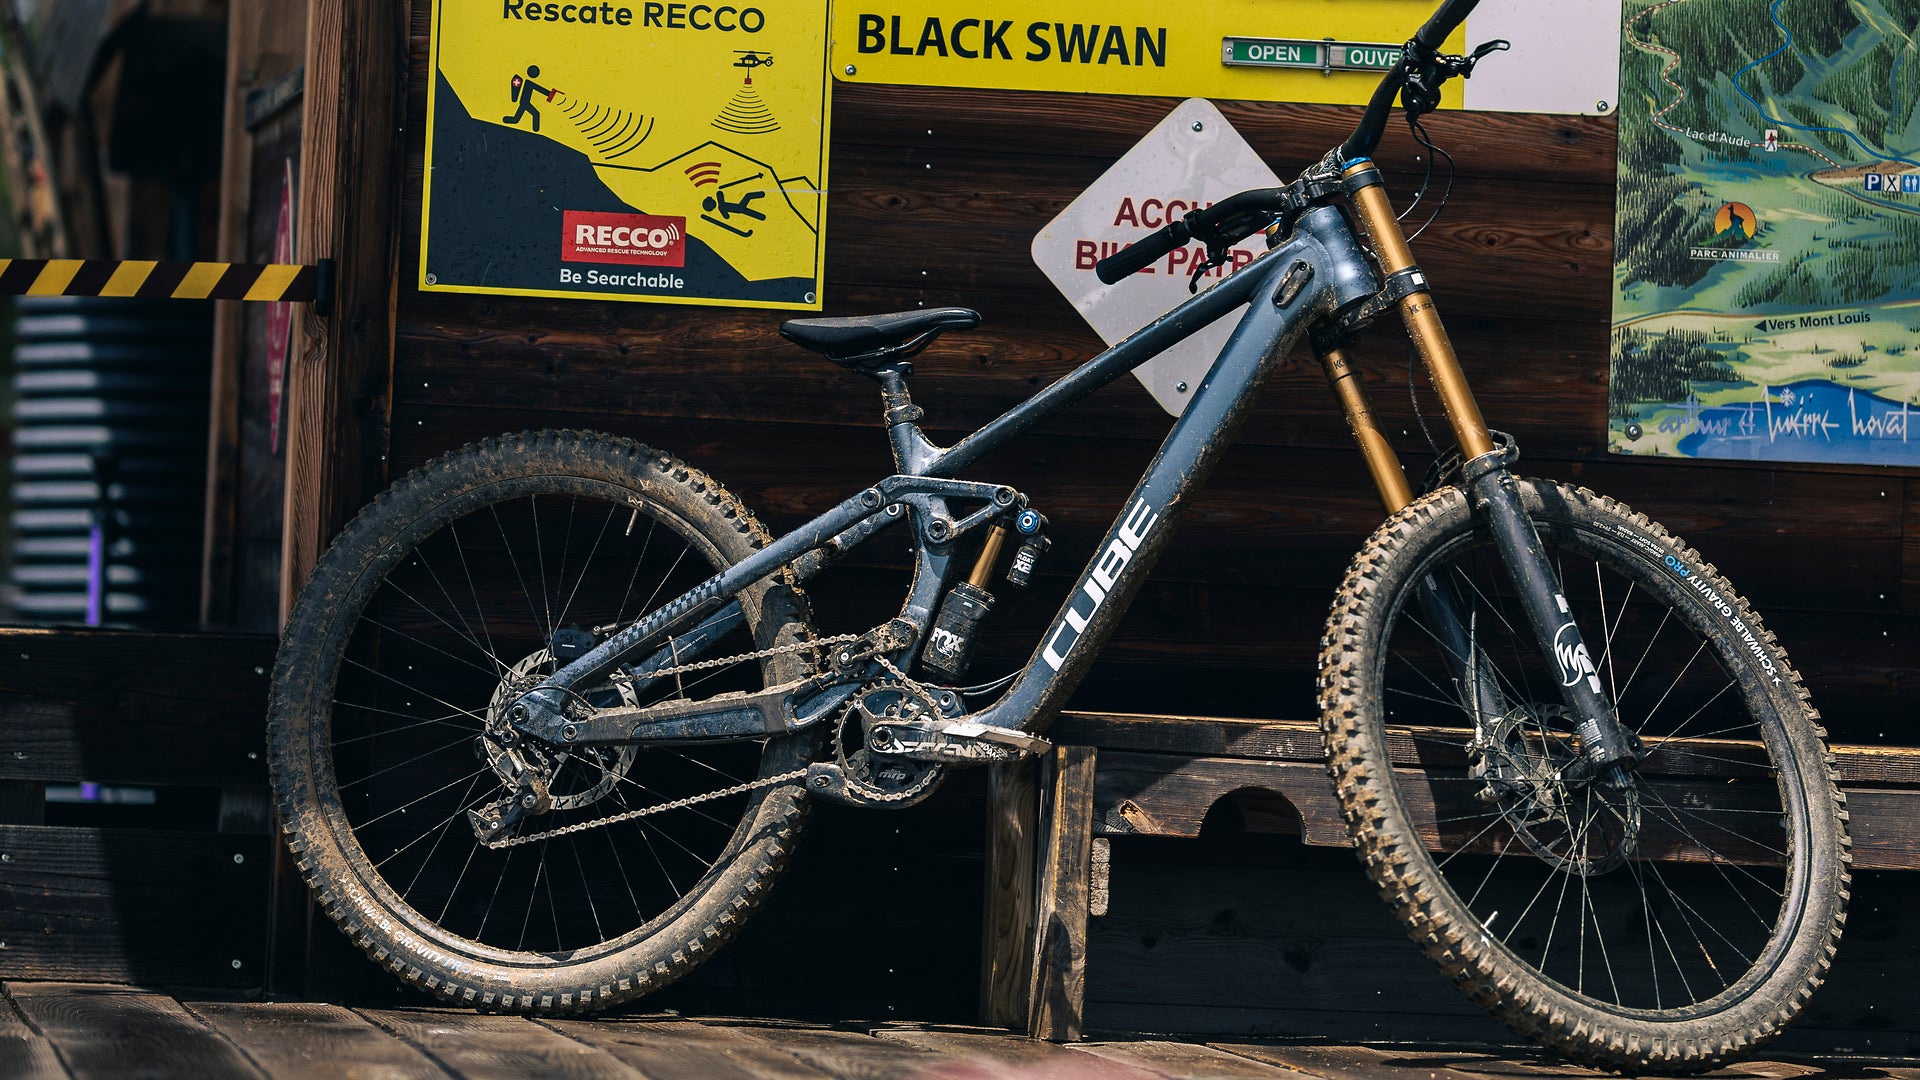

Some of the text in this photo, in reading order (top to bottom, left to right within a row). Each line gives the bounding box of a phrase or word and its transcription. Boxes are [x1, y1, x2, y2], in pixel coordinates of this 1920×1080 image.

[503, 0, 765, 33] Rescate RECCO
[857, 13, 1167, 68] BLACK SWAN
[1248, 45, 1300, 62] OPEN
[1350, 50, 1404, 66] OUVE
[1686, 127, 1751, 147] Lac d'Aude
[575, 224, 669, 248] RECCO
[575, 246, 606, 254] ADVANCED
[1690, 249, 1779, 260] PARC ANIMALIER
[560, 268, 684, 289] Be Searchable
[1768, 311, 1871, 330] Vers Mont Louis
[1042, 497, 1159, 672] CUBE
[1664, 555, 1777, 676] SCHWALBE GRAVITY PRO
[931, 627, 965, 653] FOX
